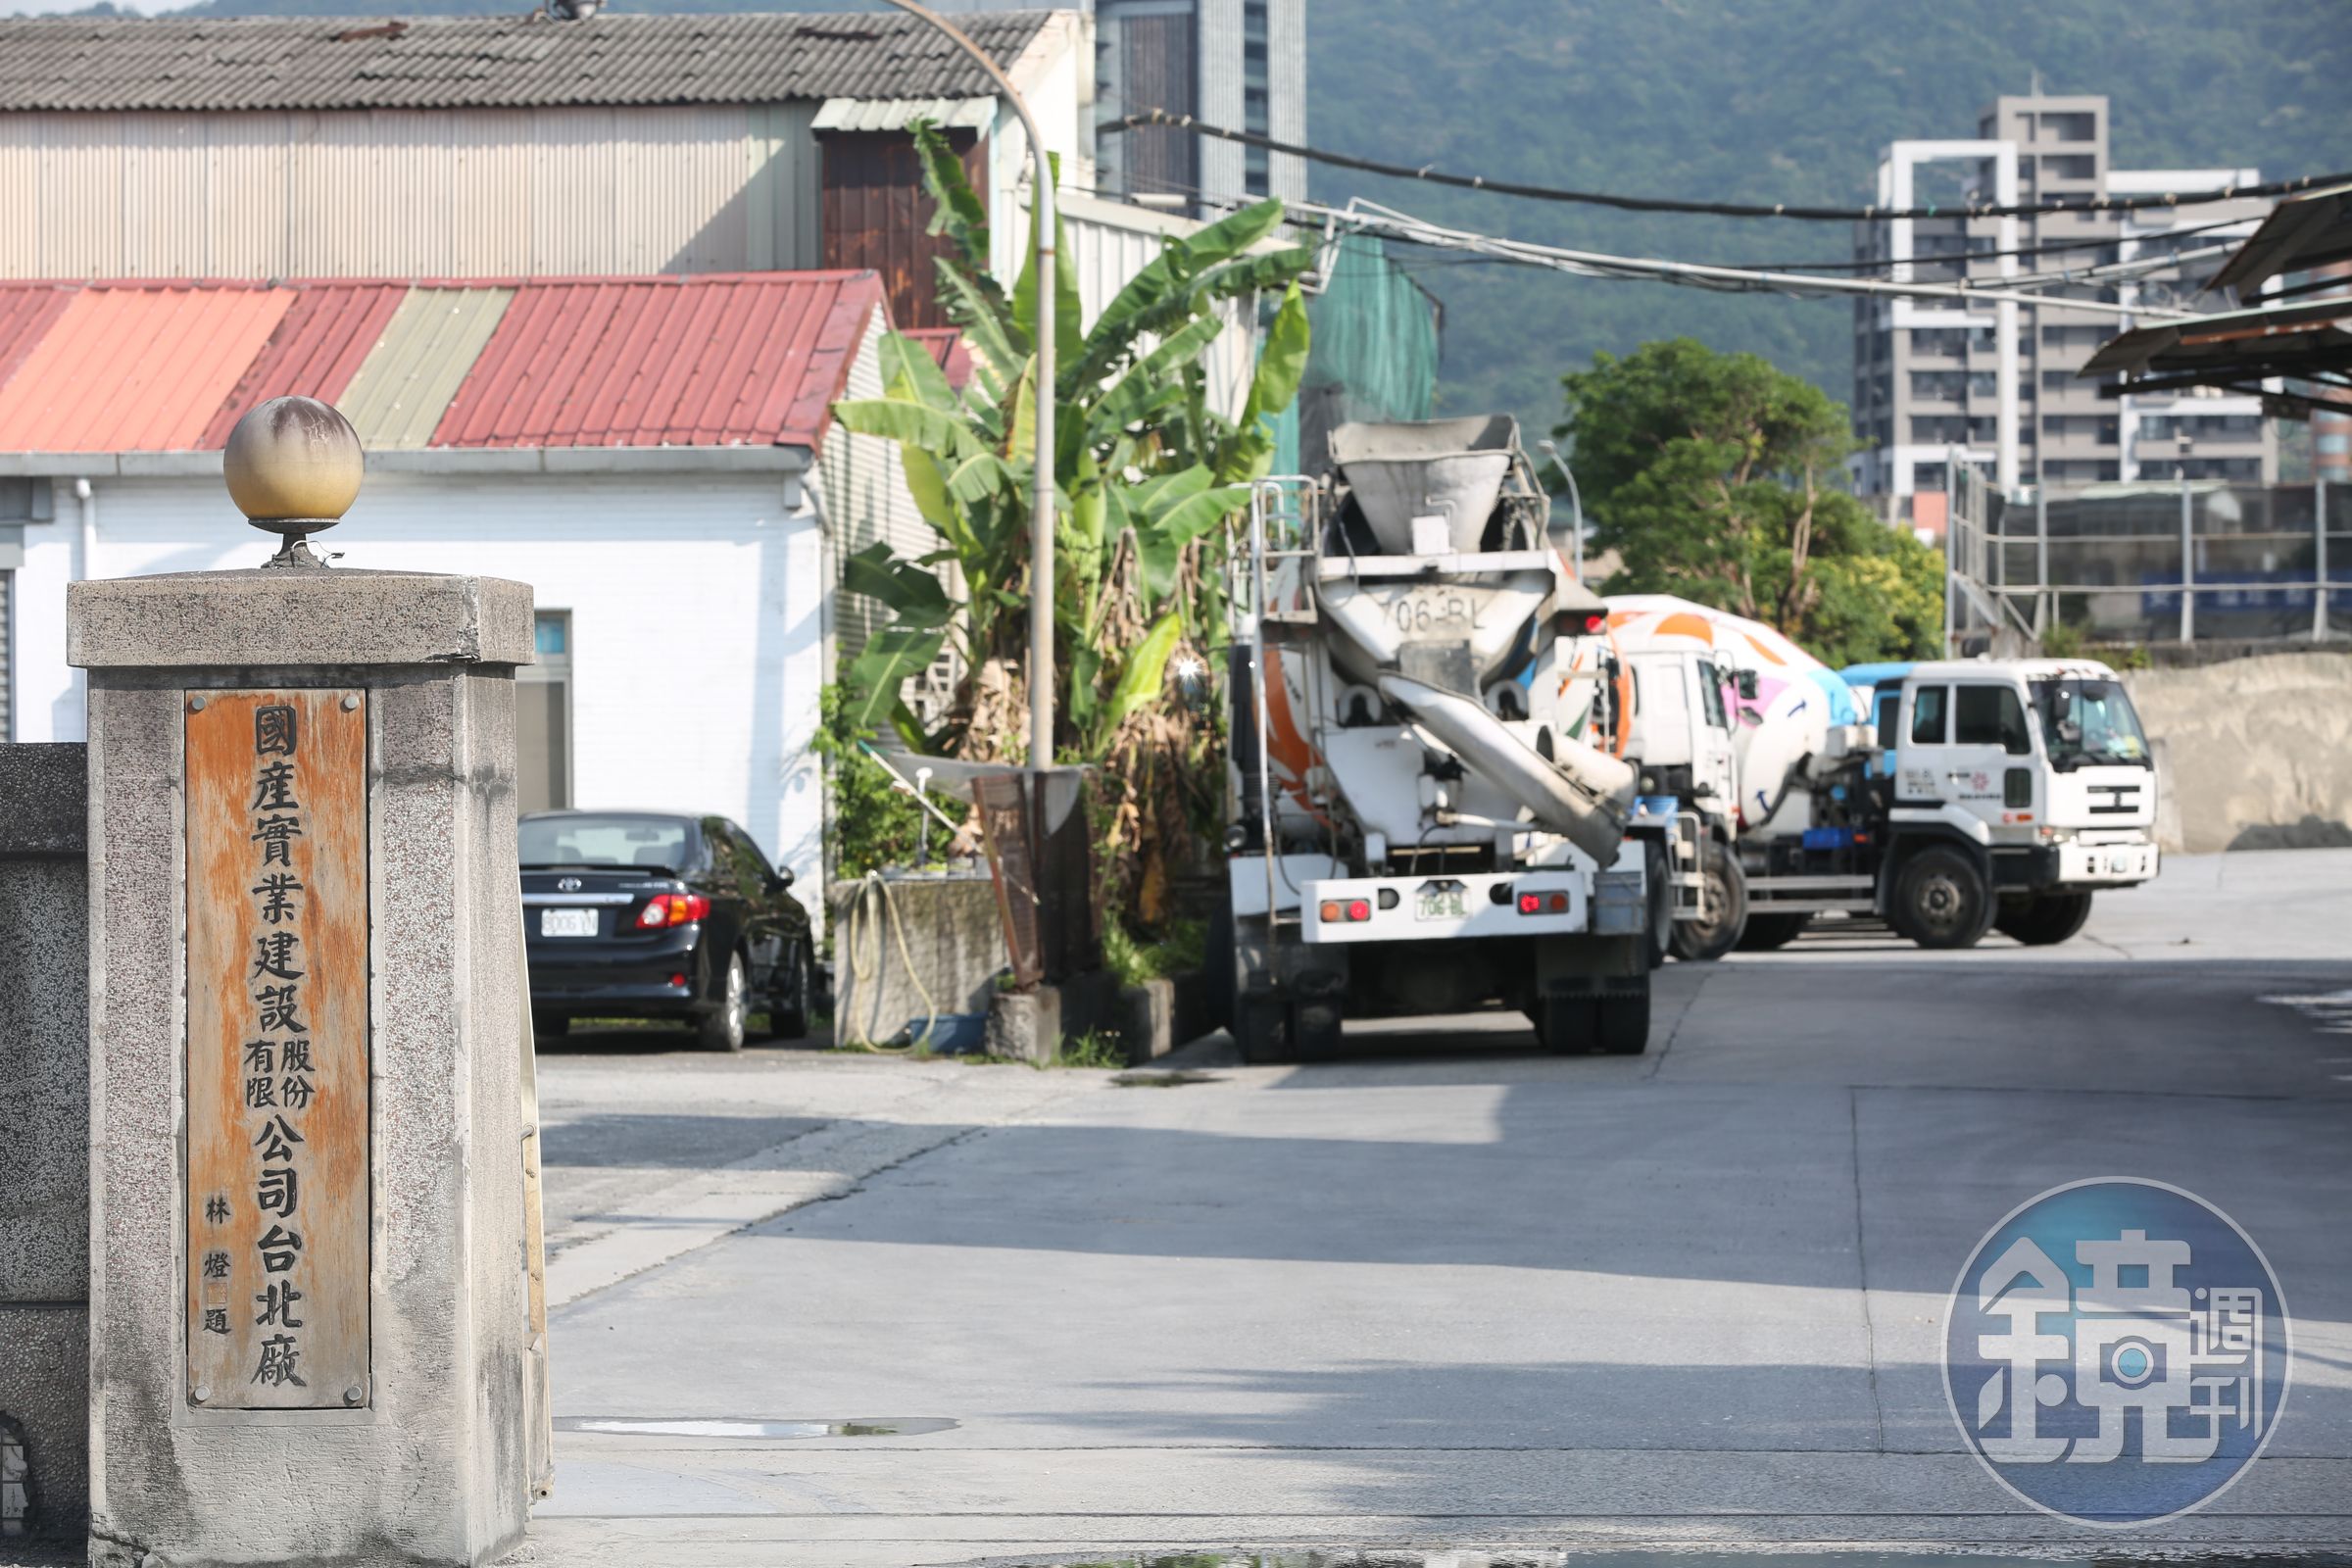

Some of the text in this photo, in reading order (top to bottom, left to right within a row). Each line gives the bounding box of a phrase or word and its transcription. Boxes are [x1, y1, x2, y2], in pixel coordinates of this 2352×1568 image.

[243, 1039, 275, 1108] 有限
[280, 1039, 316, 1109] 股份
[250, 1113, 308, 1388] 公司台北廠
